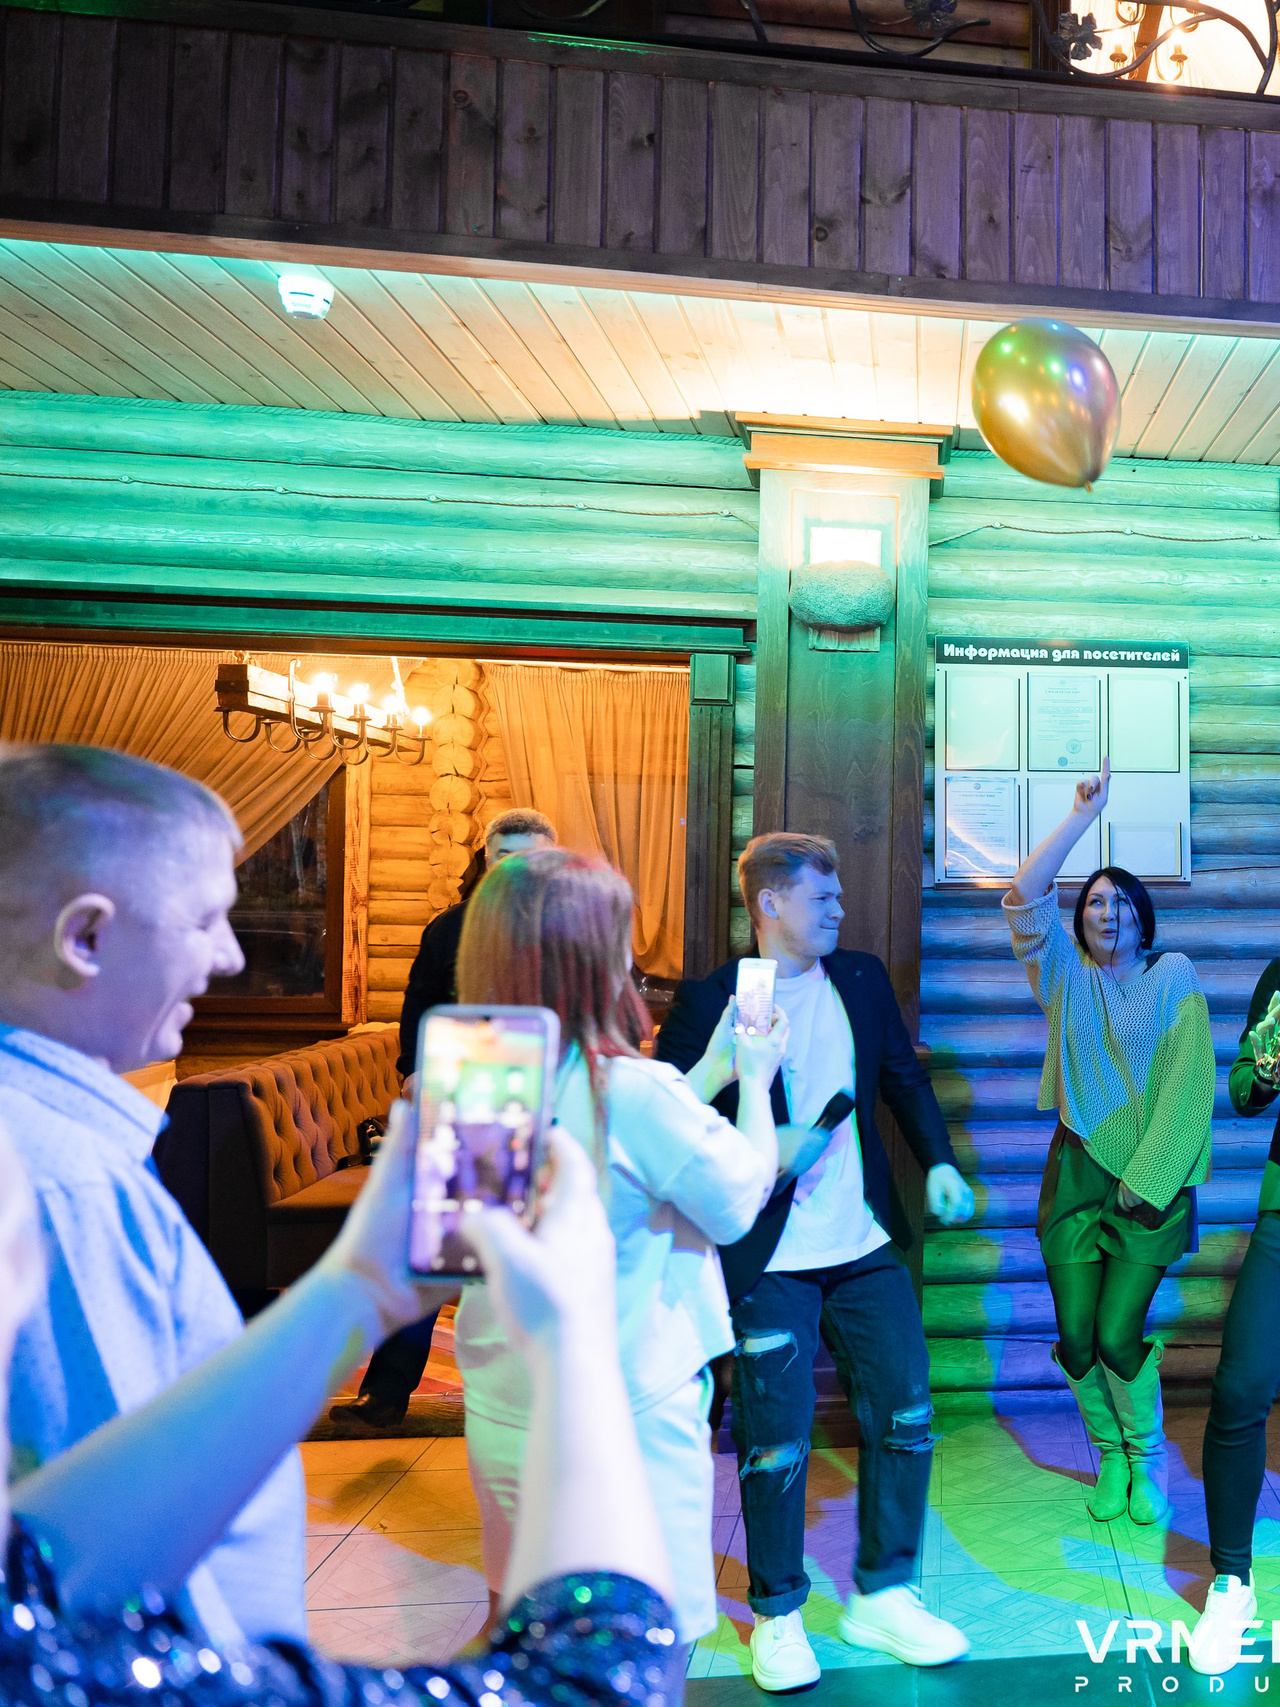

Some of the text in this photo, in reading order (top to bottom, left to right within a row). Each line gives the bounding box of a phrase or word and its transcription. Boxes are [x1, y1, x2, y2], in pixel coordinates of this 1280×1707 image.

[943, 643, 1180, 662] Информация для посетителей
